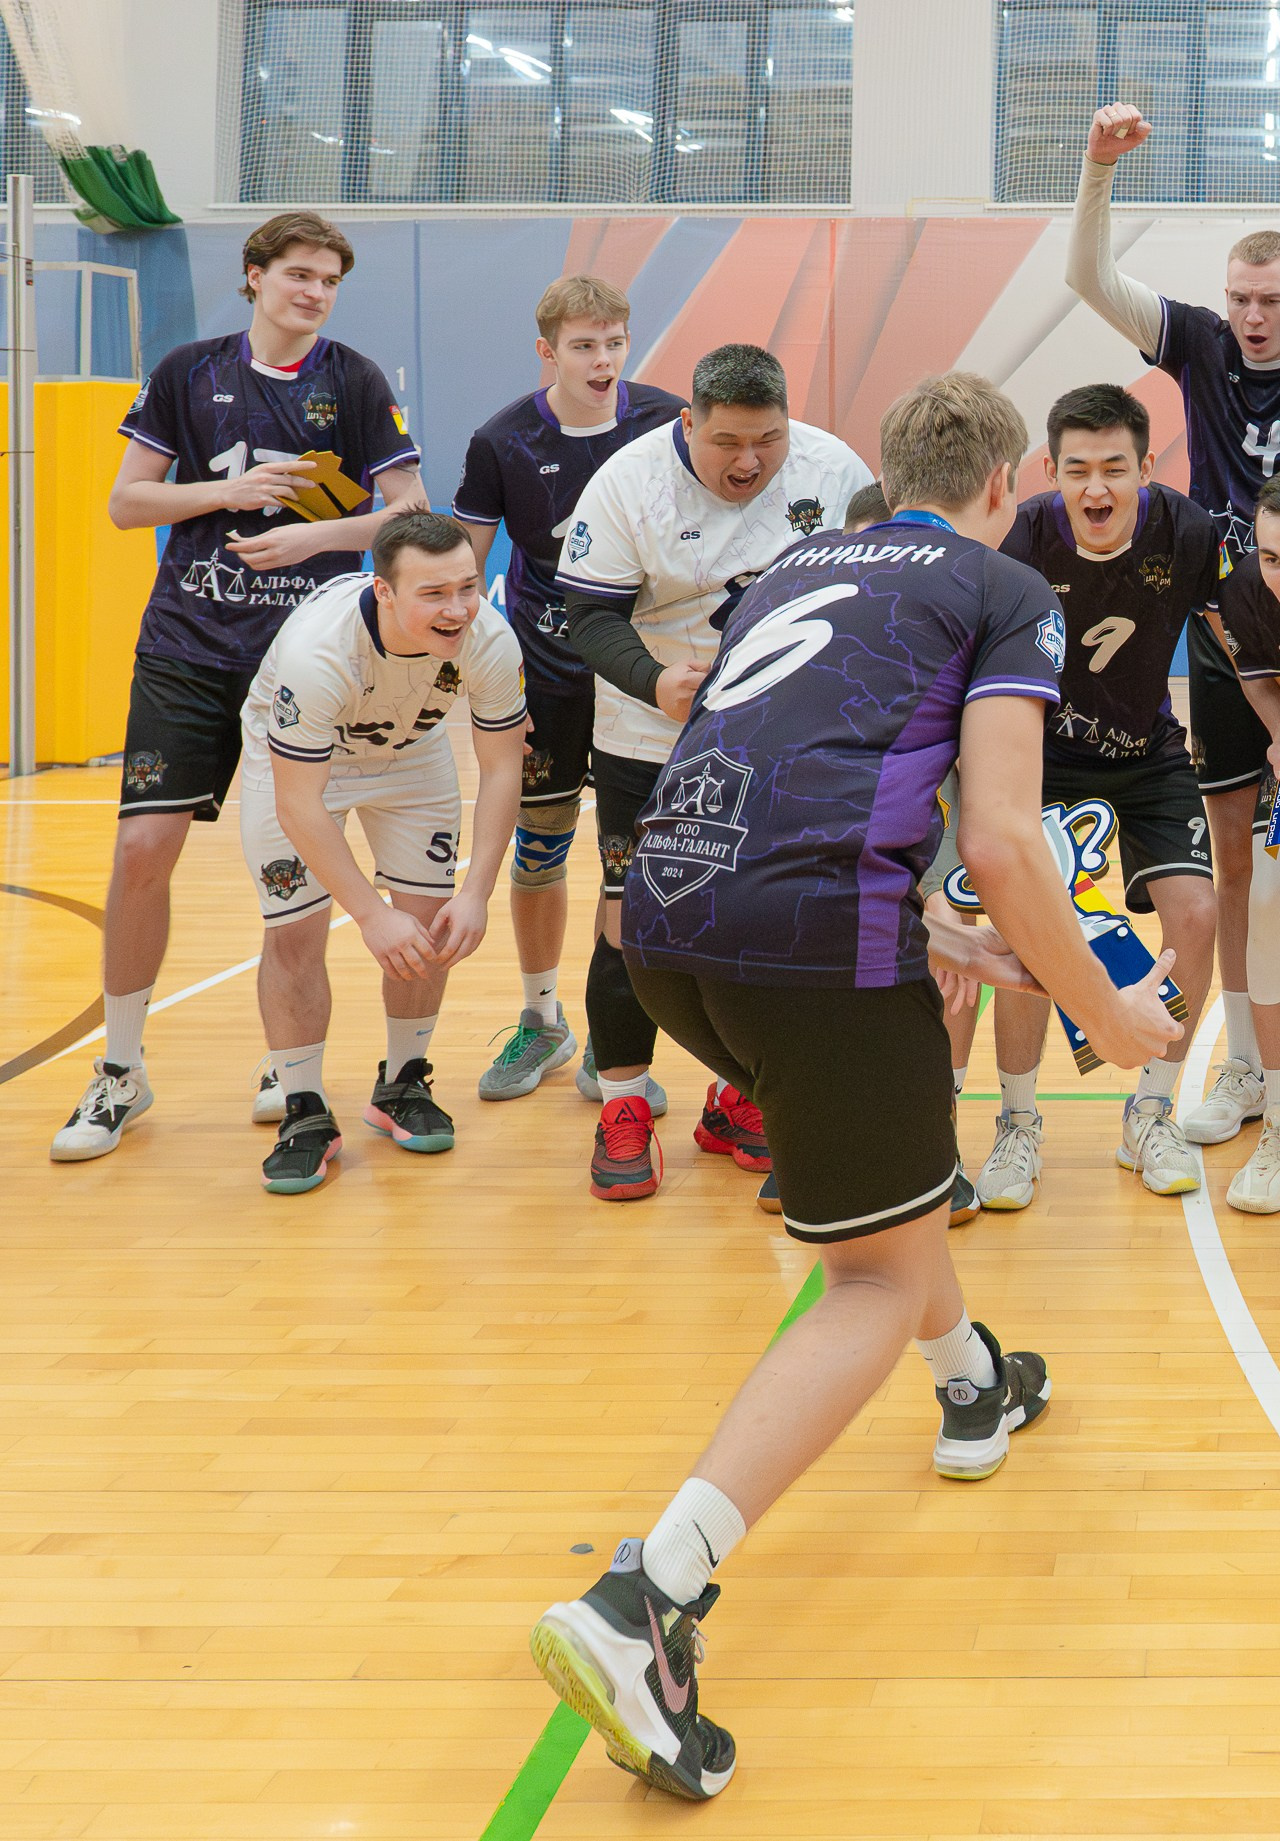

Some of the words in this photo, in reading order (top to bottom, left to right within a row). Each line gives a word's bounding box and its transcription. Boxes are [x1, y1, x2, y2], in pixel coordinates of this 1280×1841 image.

[212, 393, 235, 403] GS
[539, 463, 560, 475] GS
[680, 530, 701, 541] GS
[1051, 584, 1071, 593] GS
[1081, 616, 1136, 673] 9
[675, 822, 700, 836] ООО
[1187, 816, 1206, 846] 9
[425, 831, 460, 863] 5
[644, 834, 731, 859] АЛЬФА-ГАЛАНТ
[1190, 849, 1208, 860] GS
[661, 866, 684, 879] 2024
